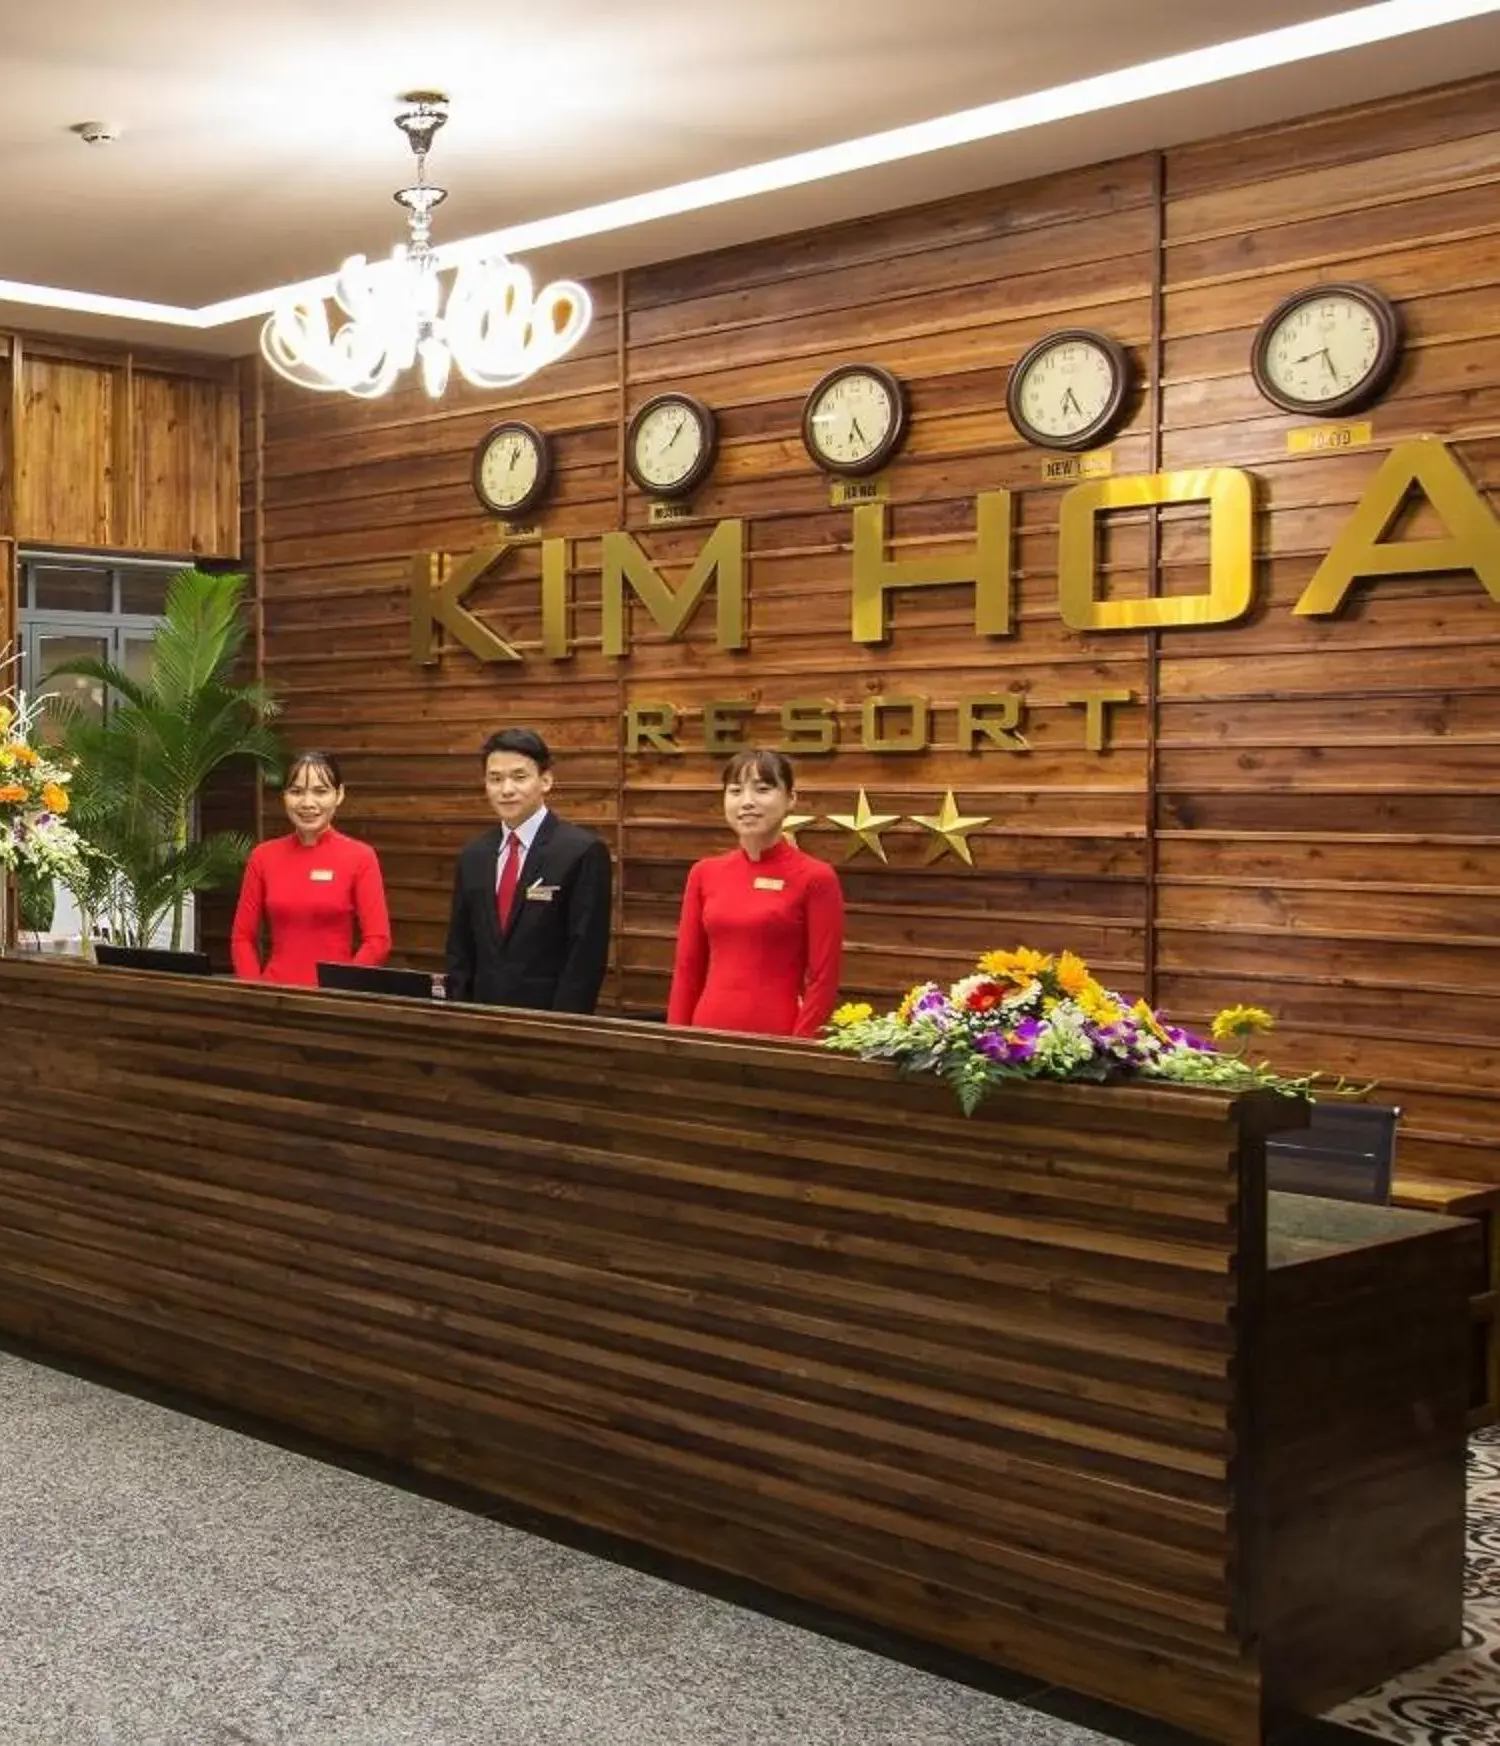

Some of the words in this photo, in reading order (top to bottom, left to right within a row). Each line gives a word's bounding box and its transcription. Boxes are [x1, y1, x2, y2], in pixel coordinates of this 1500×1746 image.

[1046, 460, 1074, 477] NEW
[410, 519, 746, 664] KIM
[851, 434, 1500, 642] HOA
[626, 690, 1138, 753] RESORT
